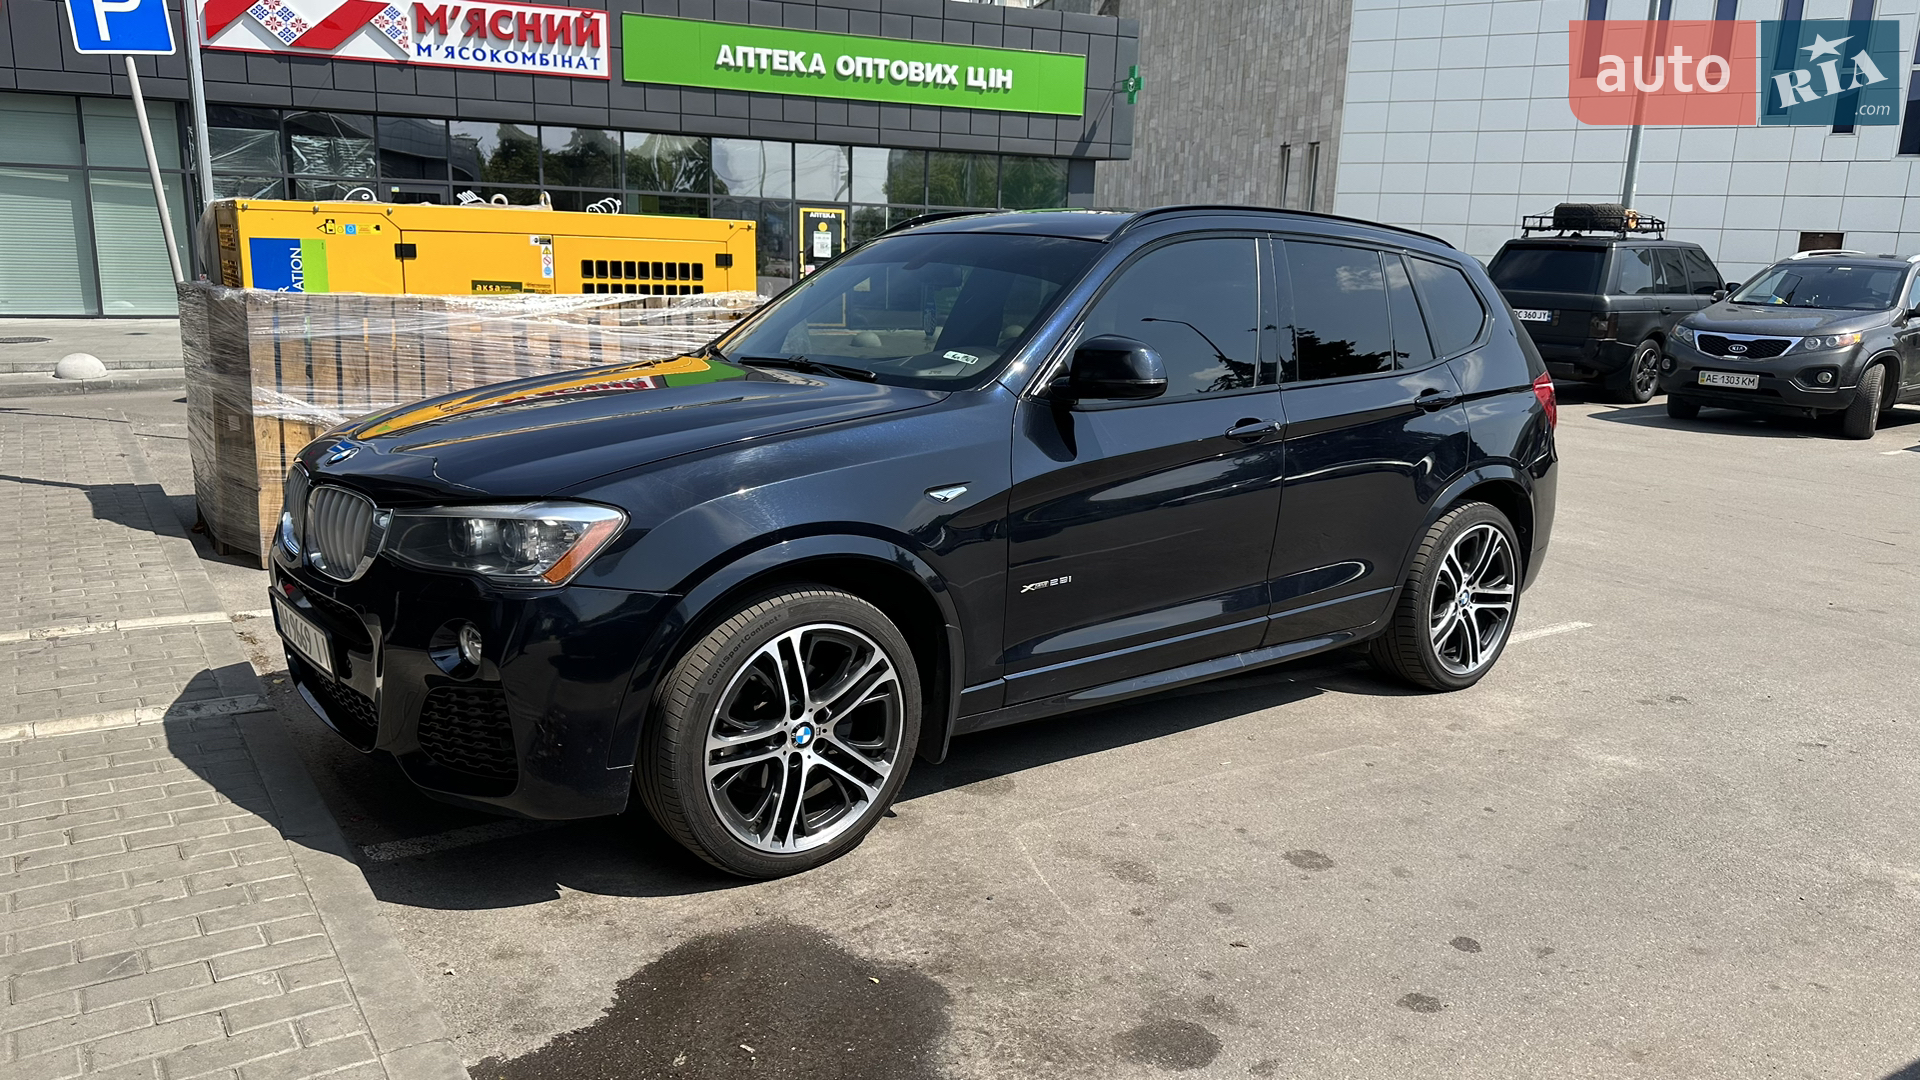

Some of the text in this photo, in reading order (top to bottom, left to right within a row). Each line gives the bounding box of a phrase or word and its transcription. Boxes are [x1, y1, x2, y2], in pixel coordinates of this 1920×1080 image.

[412, 2, 601, 48] М'ЯСНИЙ
[416, 43, 601, 71] М'ЯСОКОМБІНАТ
[716, 44, 1013, 90] АПТЕКА ОПТОВИХ ЦІН
[809, 211, 836, 219] АПТЕКА
[476, 284, 501, 292] aksa
[1524, 310, 1537, 319] 360
[1705, 374, 1756, 387] AE 1303 KM
[707, 615, 780, 686] ContiSportContact
